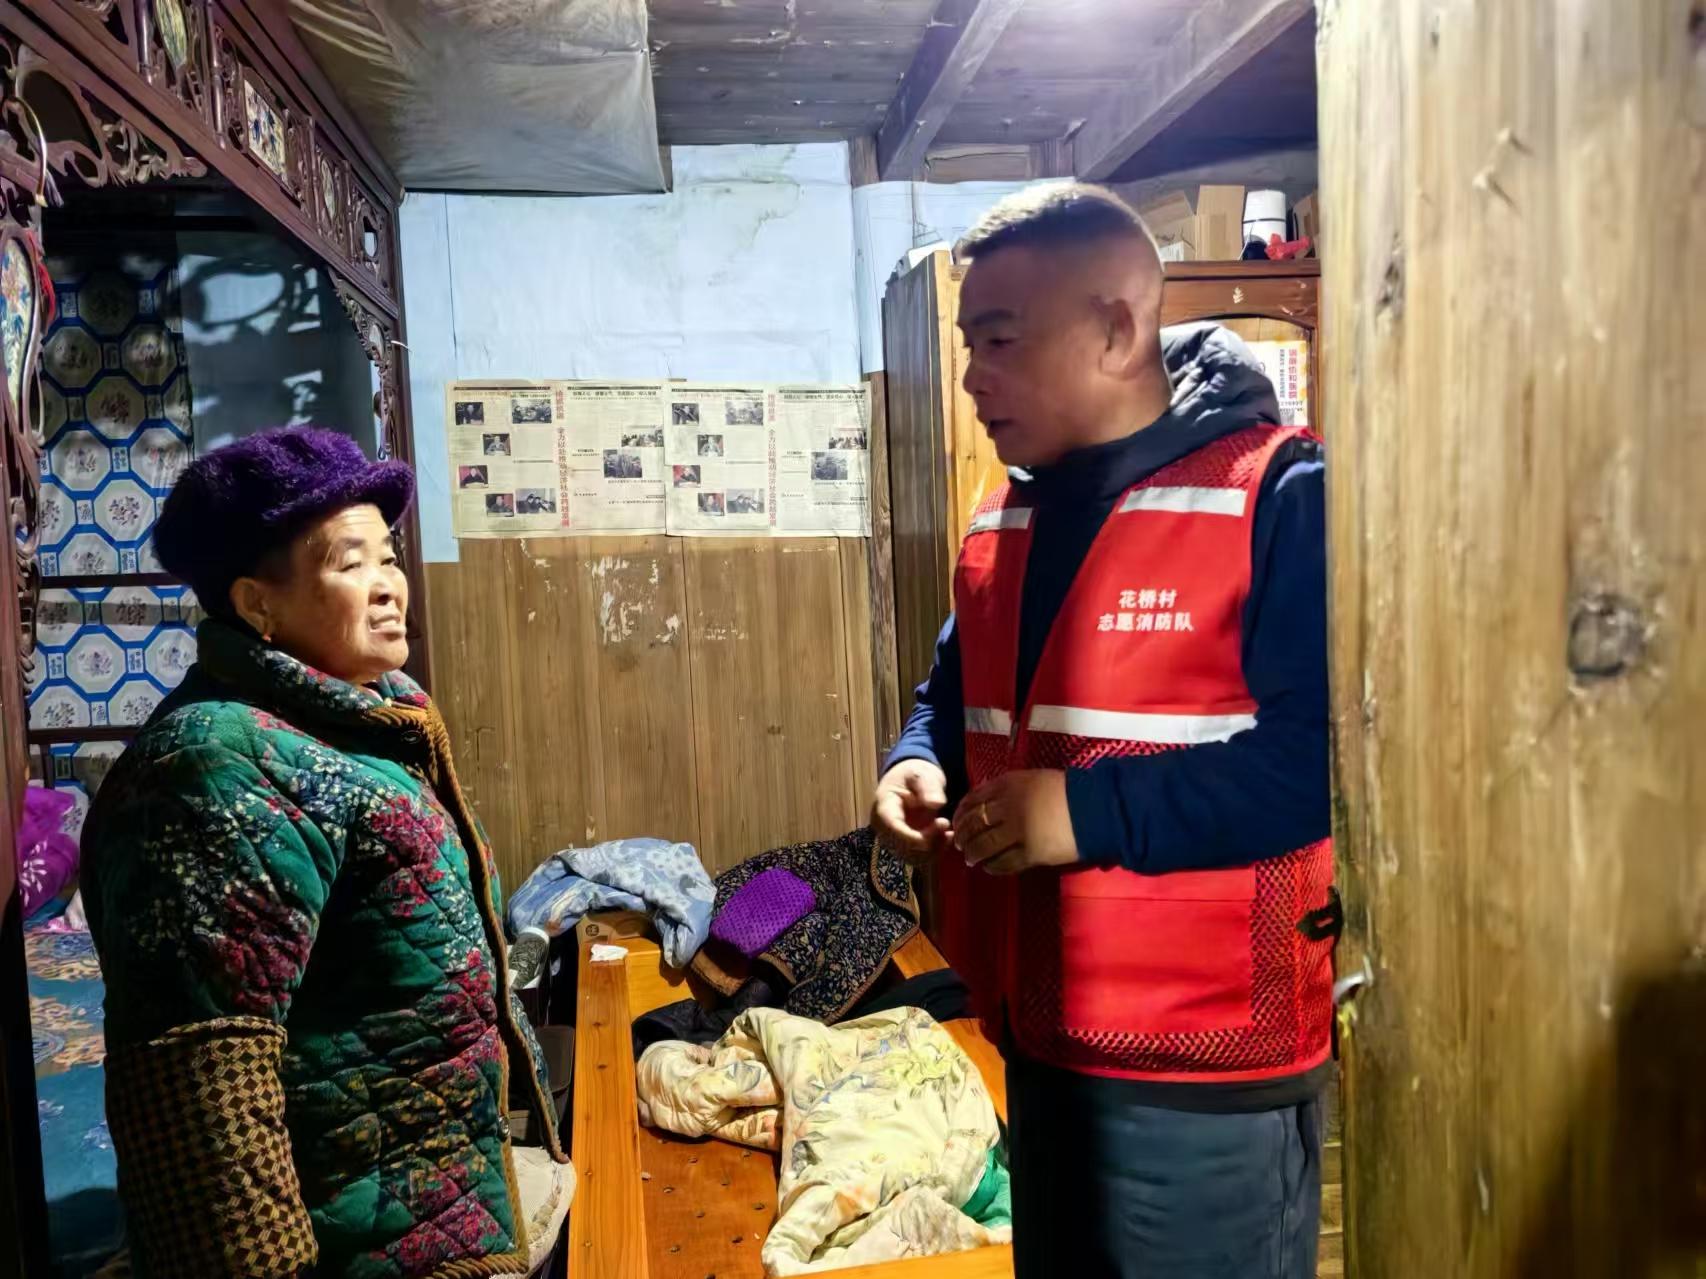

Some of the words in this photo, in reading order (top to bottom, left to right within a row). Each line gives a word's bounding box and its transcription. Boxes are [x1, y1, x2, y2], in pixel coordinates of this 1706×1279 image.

[1118, 588, 1177, 609] 花桥村
[1096, 611, 1195, 632] 志愿消防队
